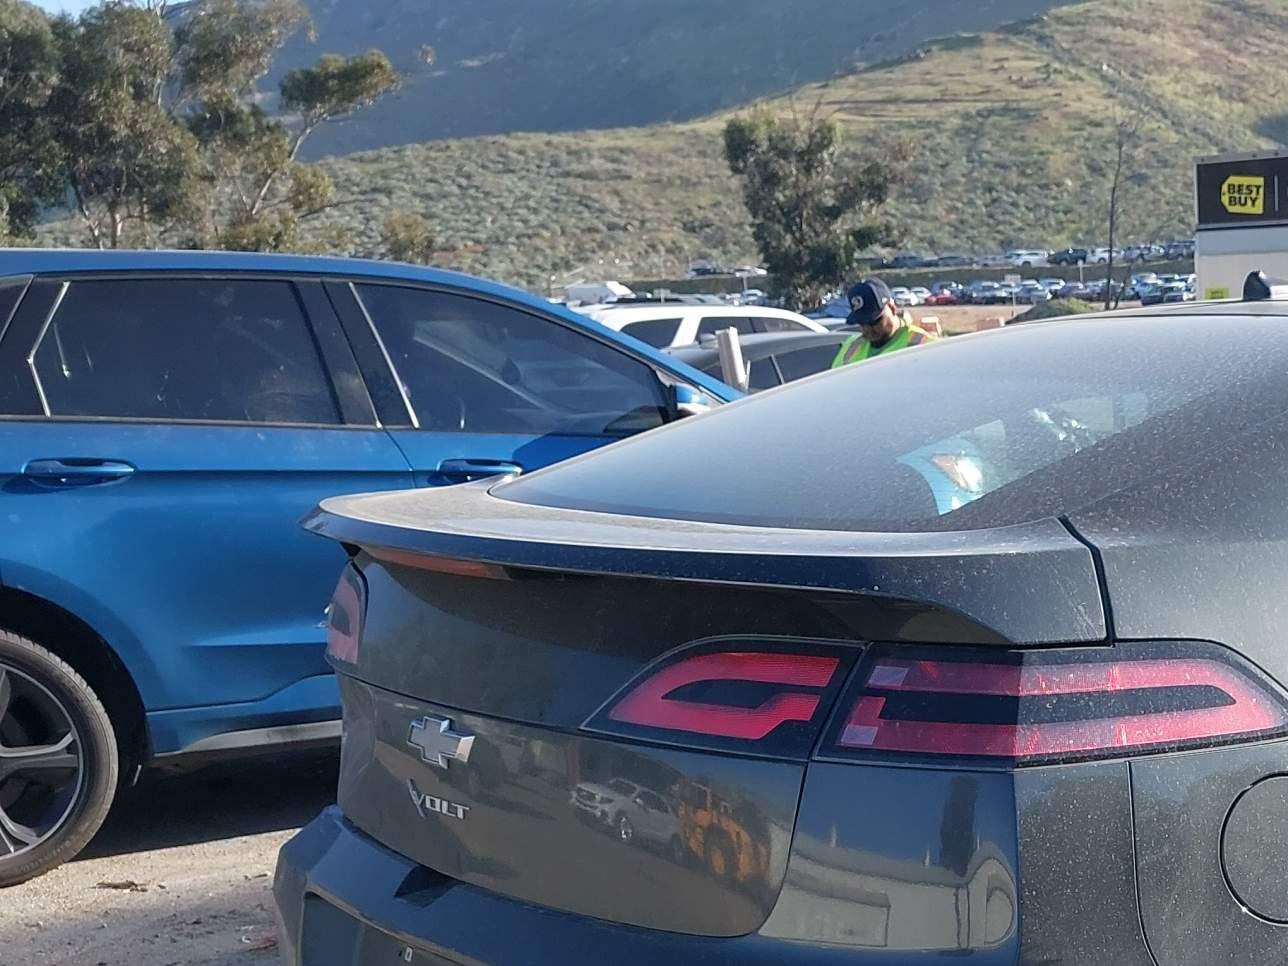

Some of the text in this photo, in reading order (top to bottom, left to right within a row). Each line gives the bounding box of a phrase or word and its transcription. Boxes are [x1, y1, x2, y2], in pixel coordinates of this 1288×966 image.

[1227, 183, 1262, 196] BEST
[1228, 195, 1258, 208] BUY
[407, 778, 471, 820] VOLT
